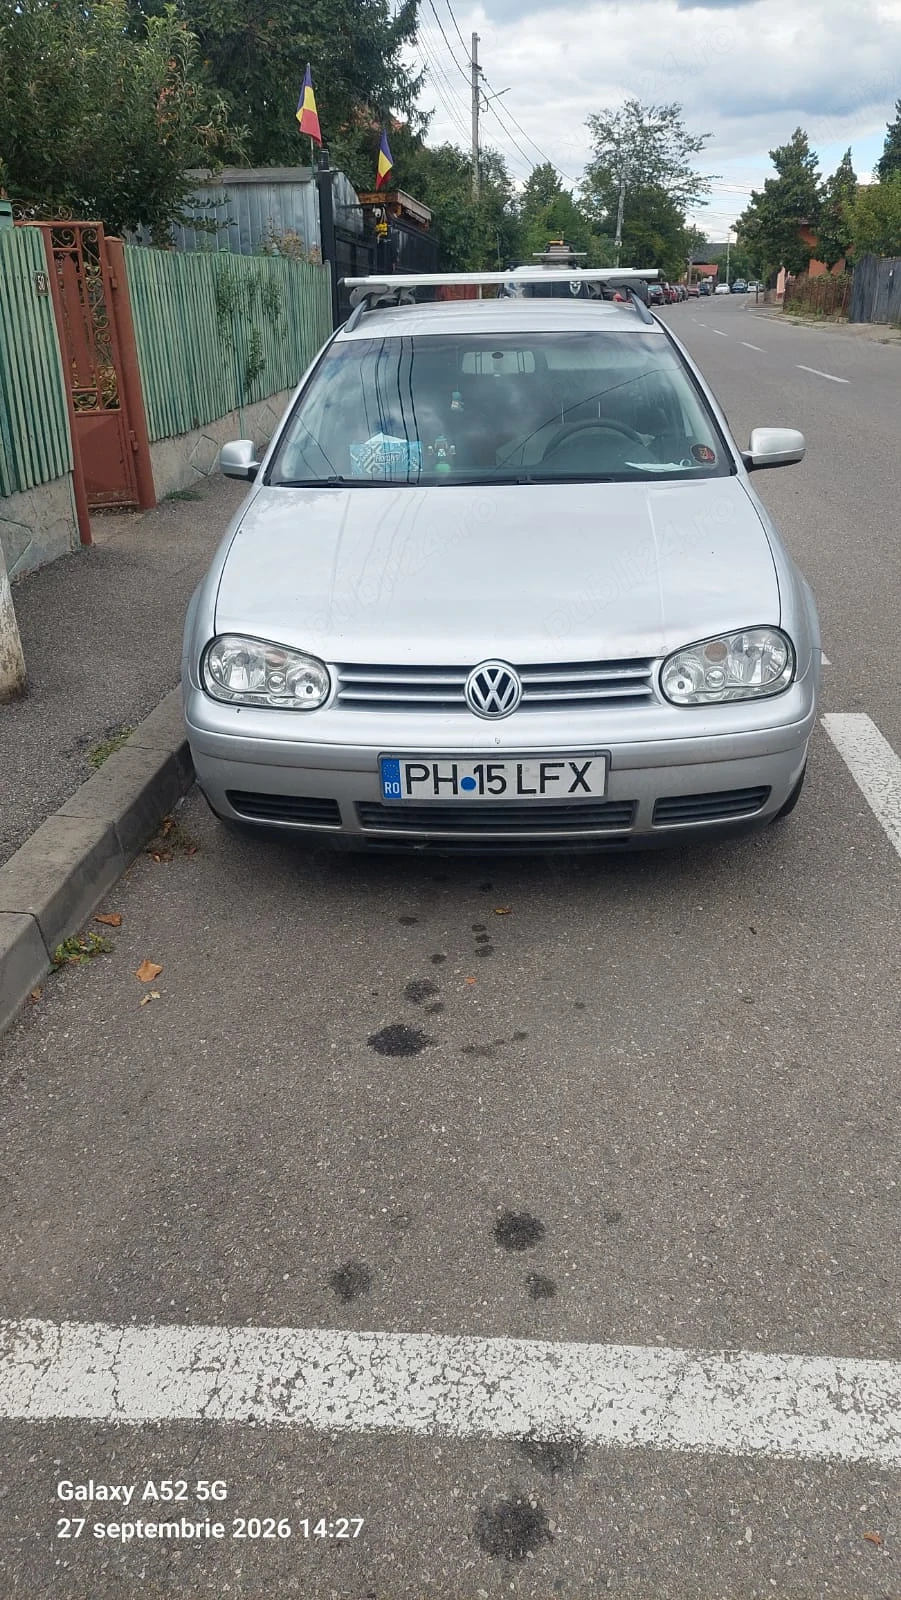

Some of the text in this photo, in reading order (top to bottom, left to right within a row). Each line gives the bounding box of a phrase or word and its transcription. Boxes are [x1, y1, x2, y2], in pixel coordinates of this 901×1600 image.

[470, 666, 516, 713] VW
[384, 781, 400, 795] RO
[405, 760, 593, 795] PH 15 LFX
